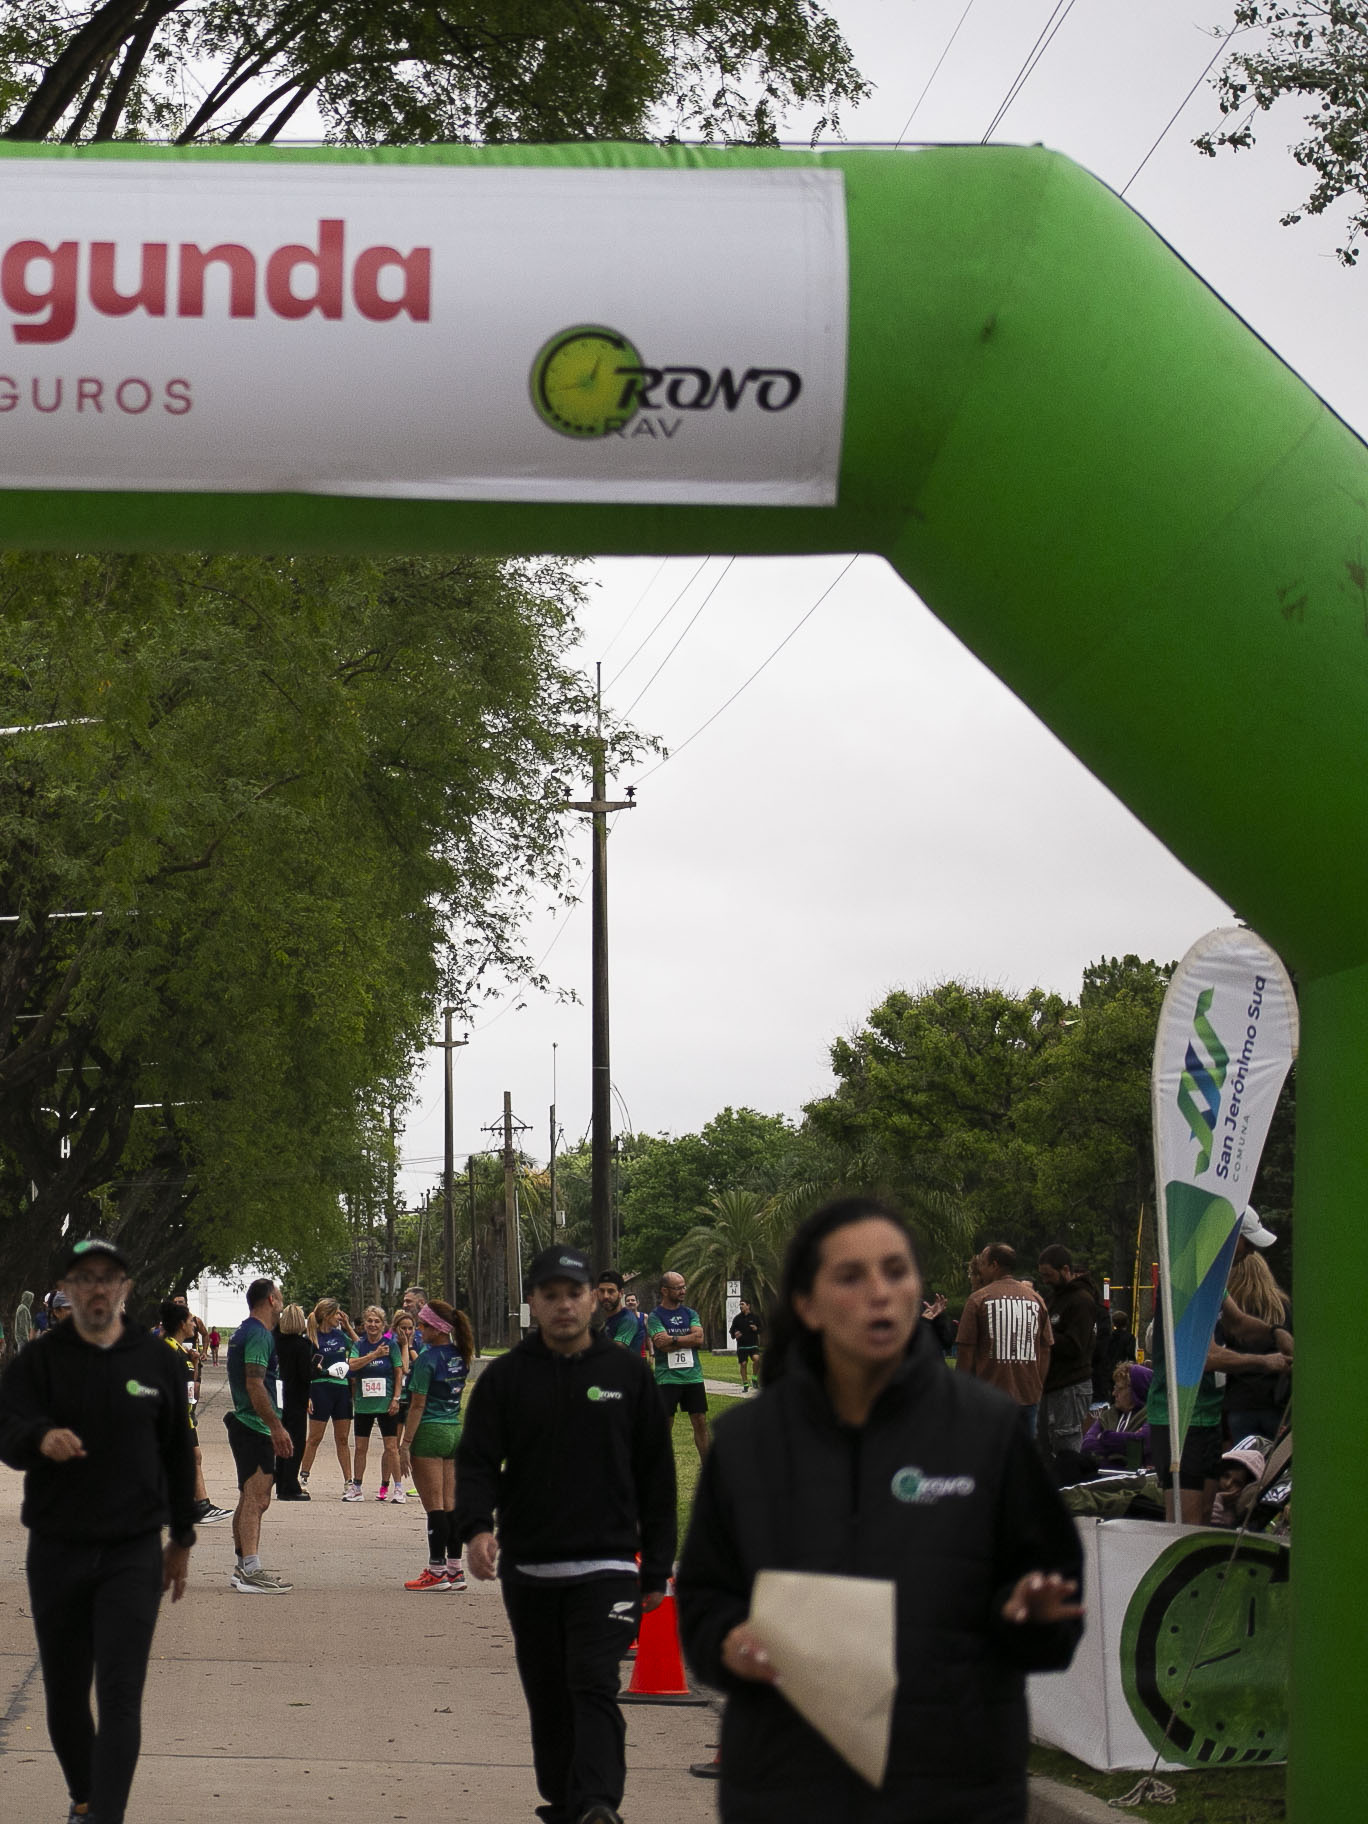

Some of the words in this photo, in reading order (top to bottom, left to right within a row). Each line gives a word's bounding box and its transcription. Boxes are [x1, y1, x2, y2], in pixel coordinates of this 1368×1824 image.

[1247, 974, 1267, 1021] Sud
[1224, 1025, 1257, 1133] Jerónimo
[1216, 1136, 1234, 1180] San
[1232, 1114, 1251, 1183] COMUNA
[984, 1299, 1040, 1361] THINGS
[335, 1366, 344, 1376] 18
[675, 1353, 686, 1363] 76
[365, 1382, 381, 1392] 544
